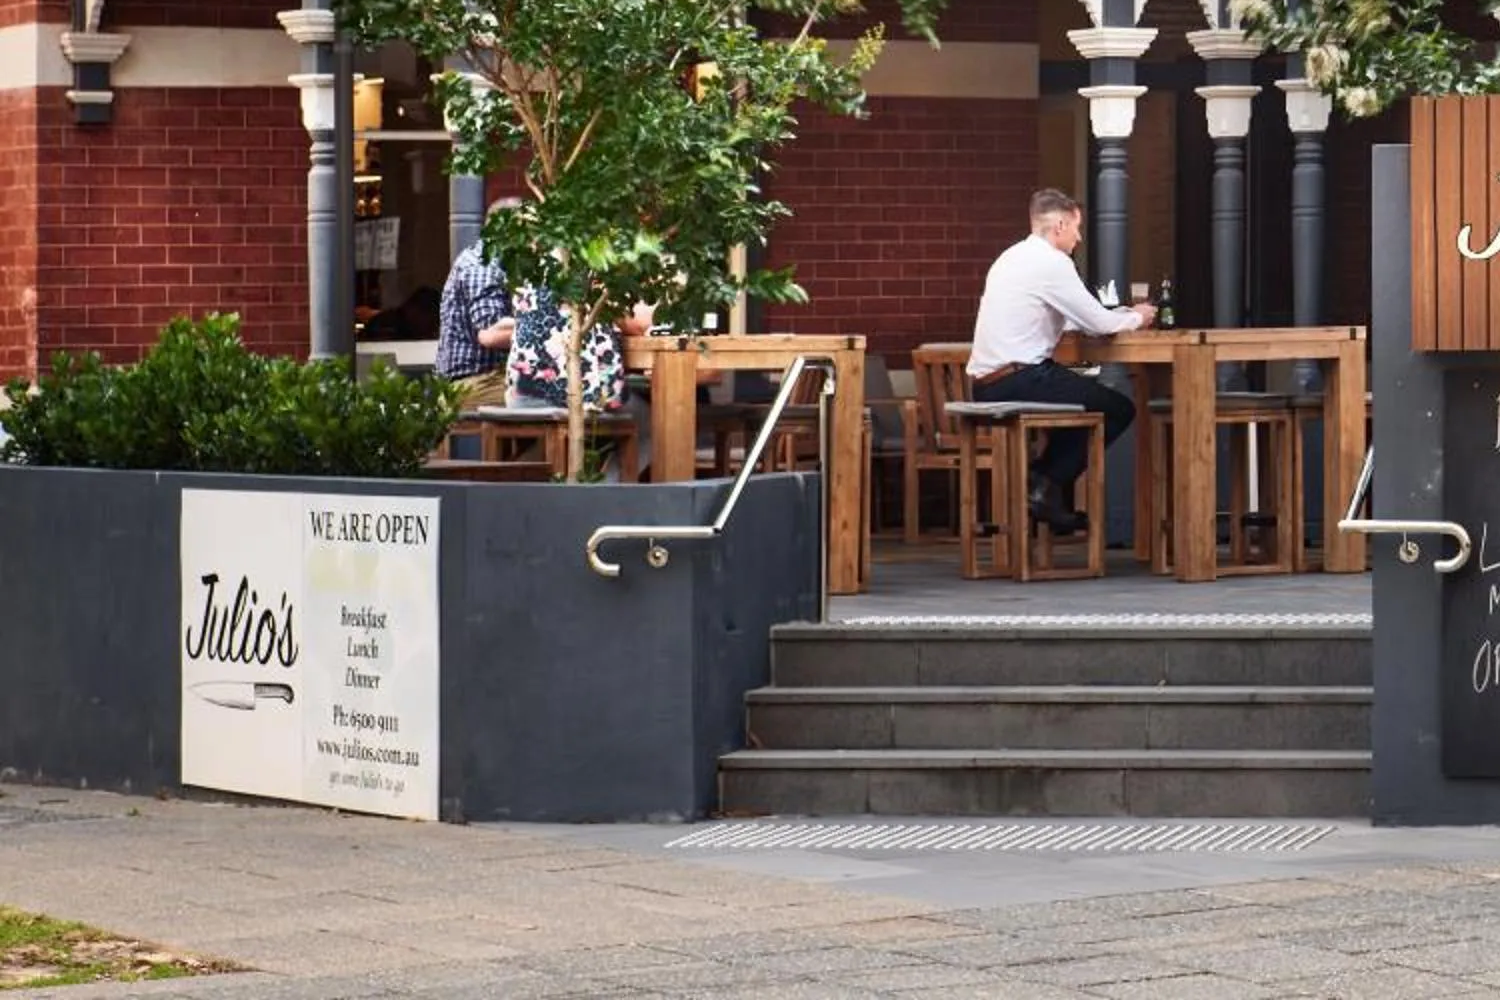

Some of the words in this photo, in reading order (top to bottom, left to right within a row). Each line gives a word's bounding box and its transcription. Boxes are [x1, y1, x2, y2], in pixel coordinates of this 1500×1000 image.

[309, 511, 335, 541] WE
[337, 513, 372, 543] ARE
[375, 513, 430, 545] OPEN
[186, 573, 298, 668] Julio's
